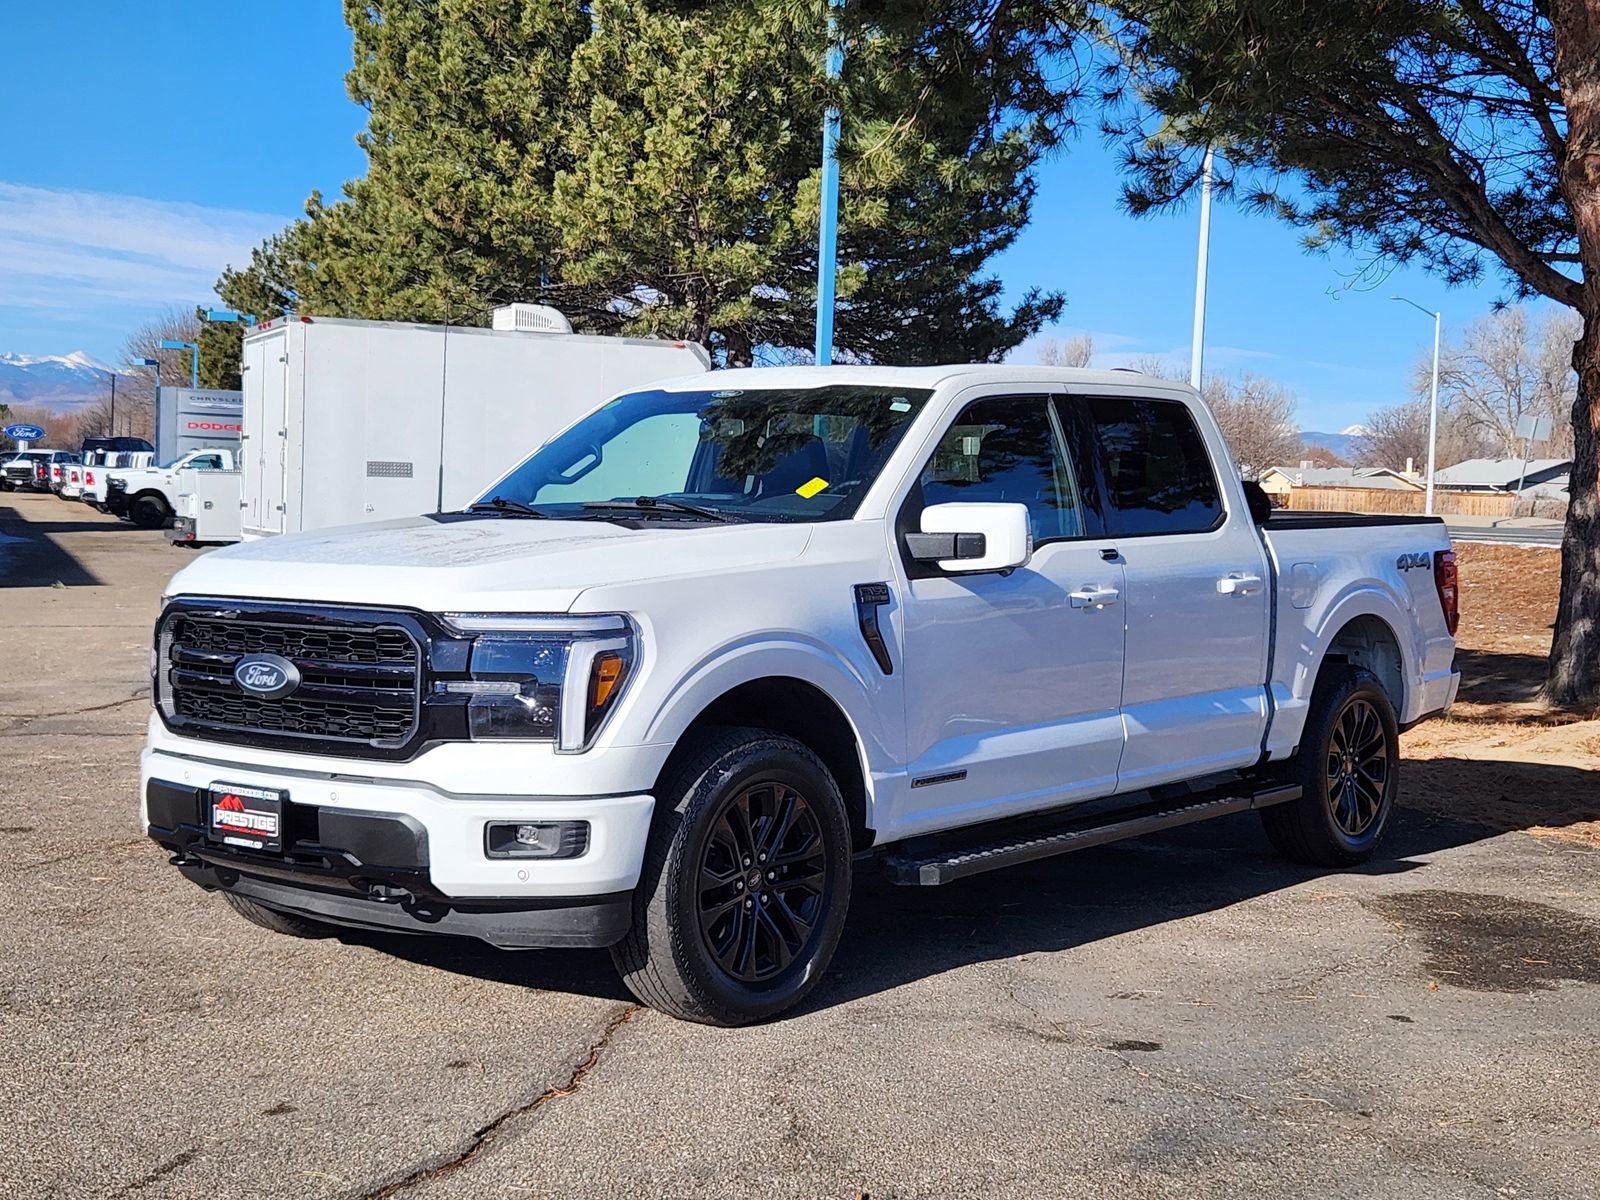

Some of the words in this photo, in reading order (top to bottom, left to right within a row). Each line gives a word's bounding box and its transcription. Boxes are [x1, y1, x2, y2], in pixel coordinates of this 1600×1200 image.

[13, 427, 37, 438] Ford
[246, 665, 277, 686] Ford
[216, 809, 276, 832] PRESTIGE
